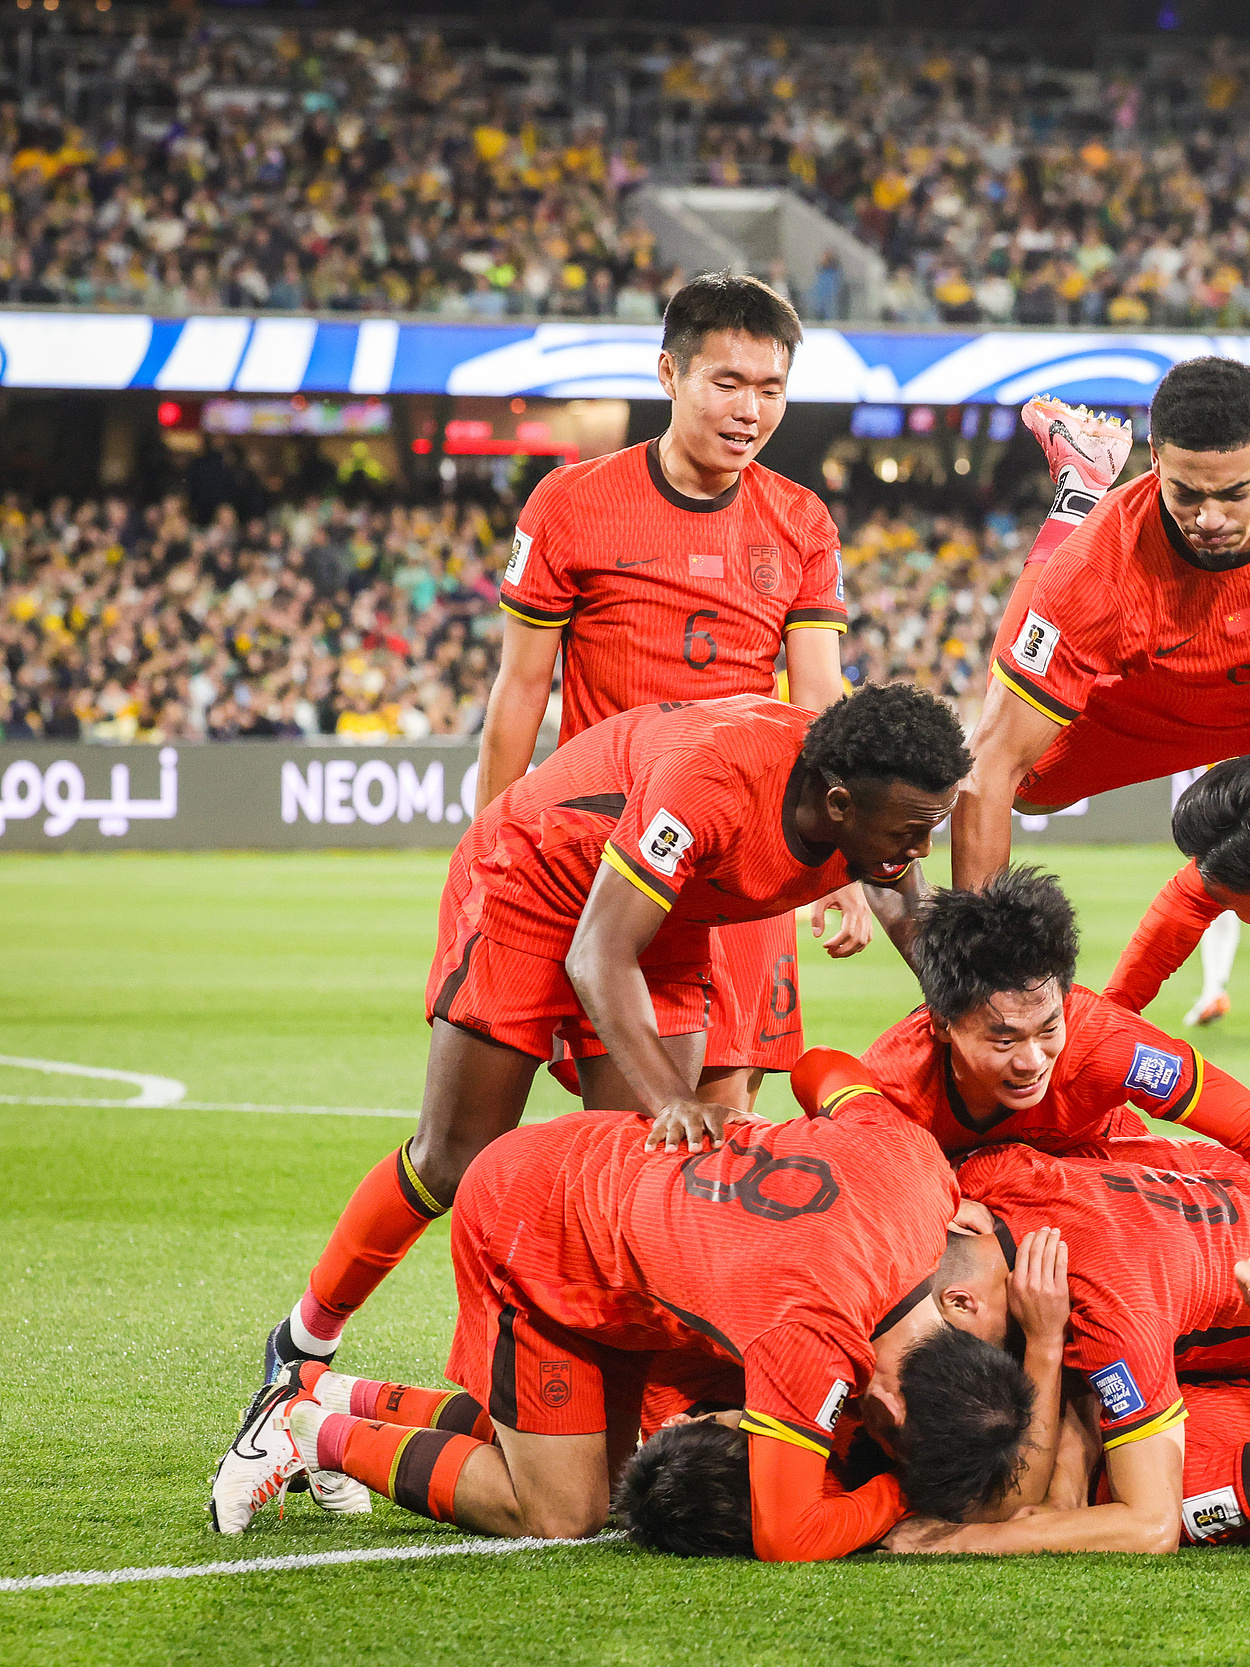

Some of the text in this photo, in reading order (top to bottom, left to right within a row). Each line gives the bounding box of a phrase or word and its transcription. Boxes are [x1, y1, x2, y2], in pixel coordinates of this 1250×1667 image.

[682, 608, 719, 671] 6
[770, 954, 797, 1020] 6
[681, 1138, 841, 1222] 8
